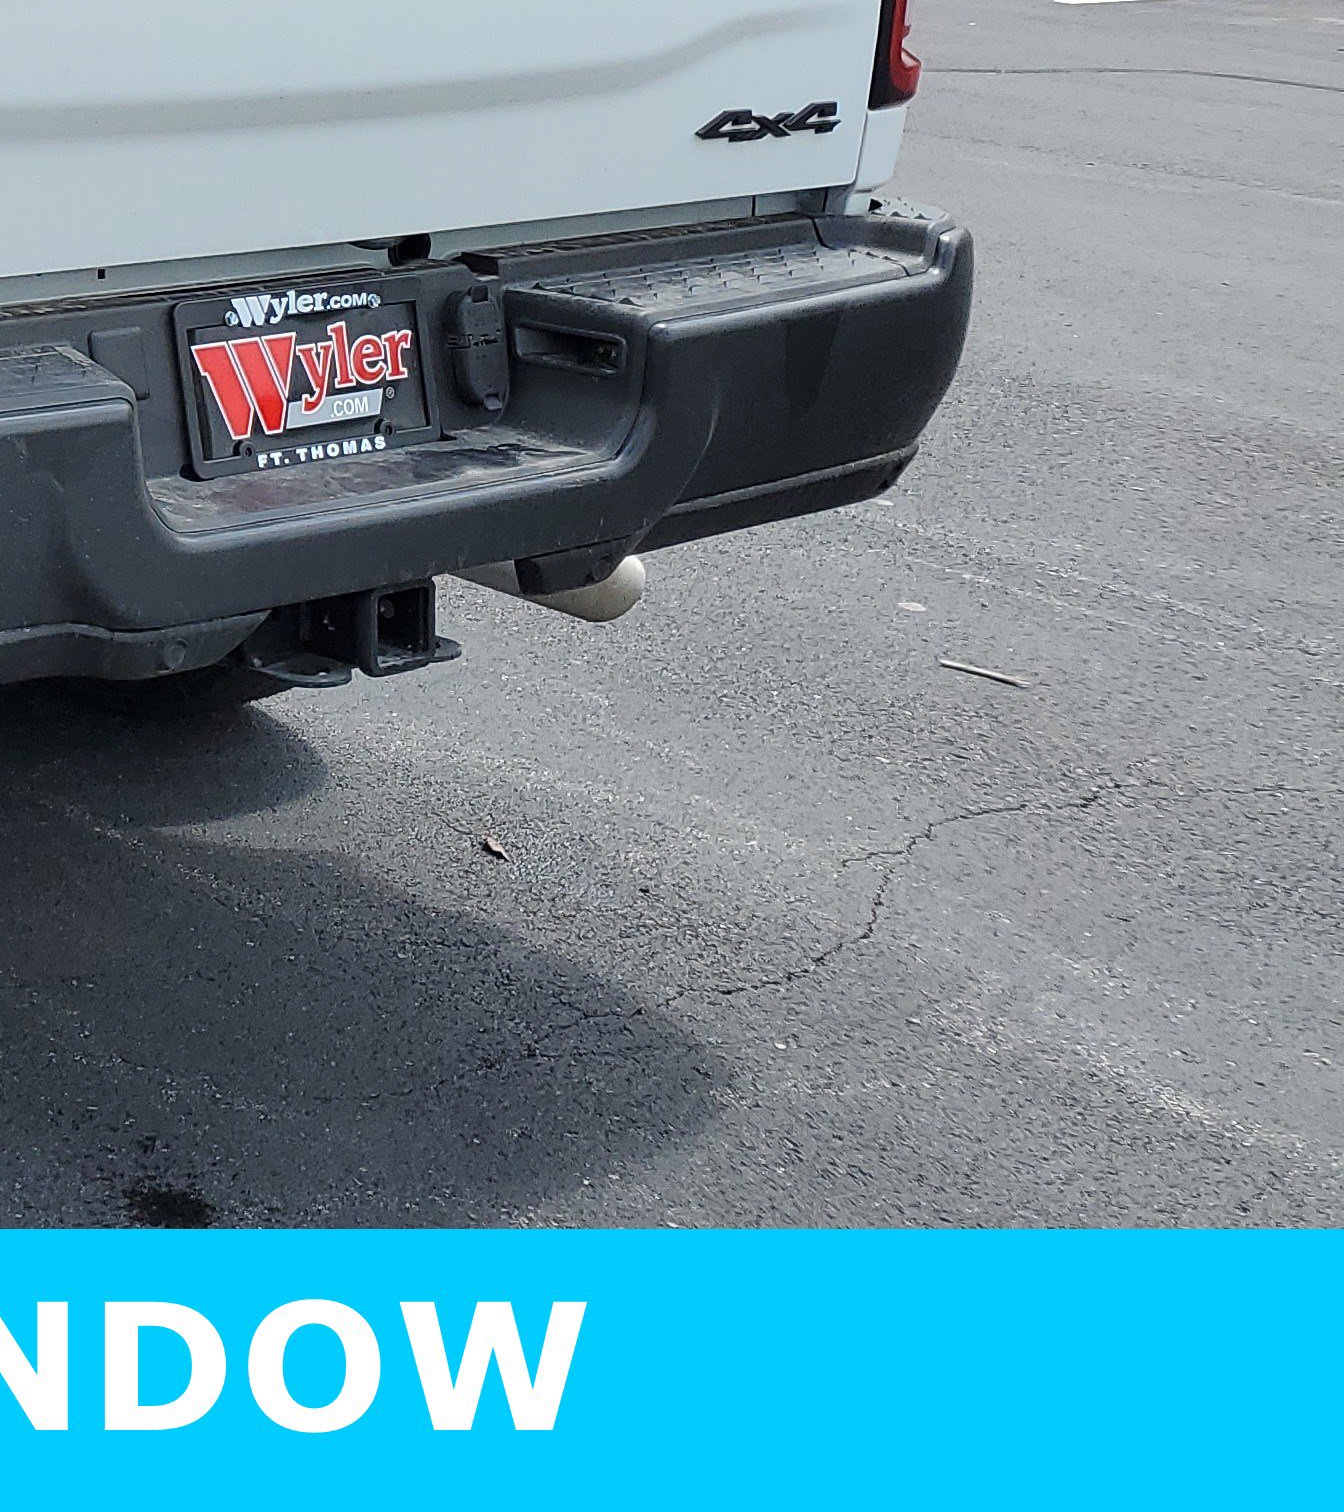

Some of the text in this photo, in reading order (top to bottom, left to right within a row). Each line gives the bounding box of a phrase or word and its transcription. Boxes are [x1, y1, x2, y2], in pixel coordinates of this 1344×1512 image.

[694, 101, 842, 143] 4x4
[191, 321, 412, 440] Wyler
[258, 436, 387, 468] FT. THOMAS
